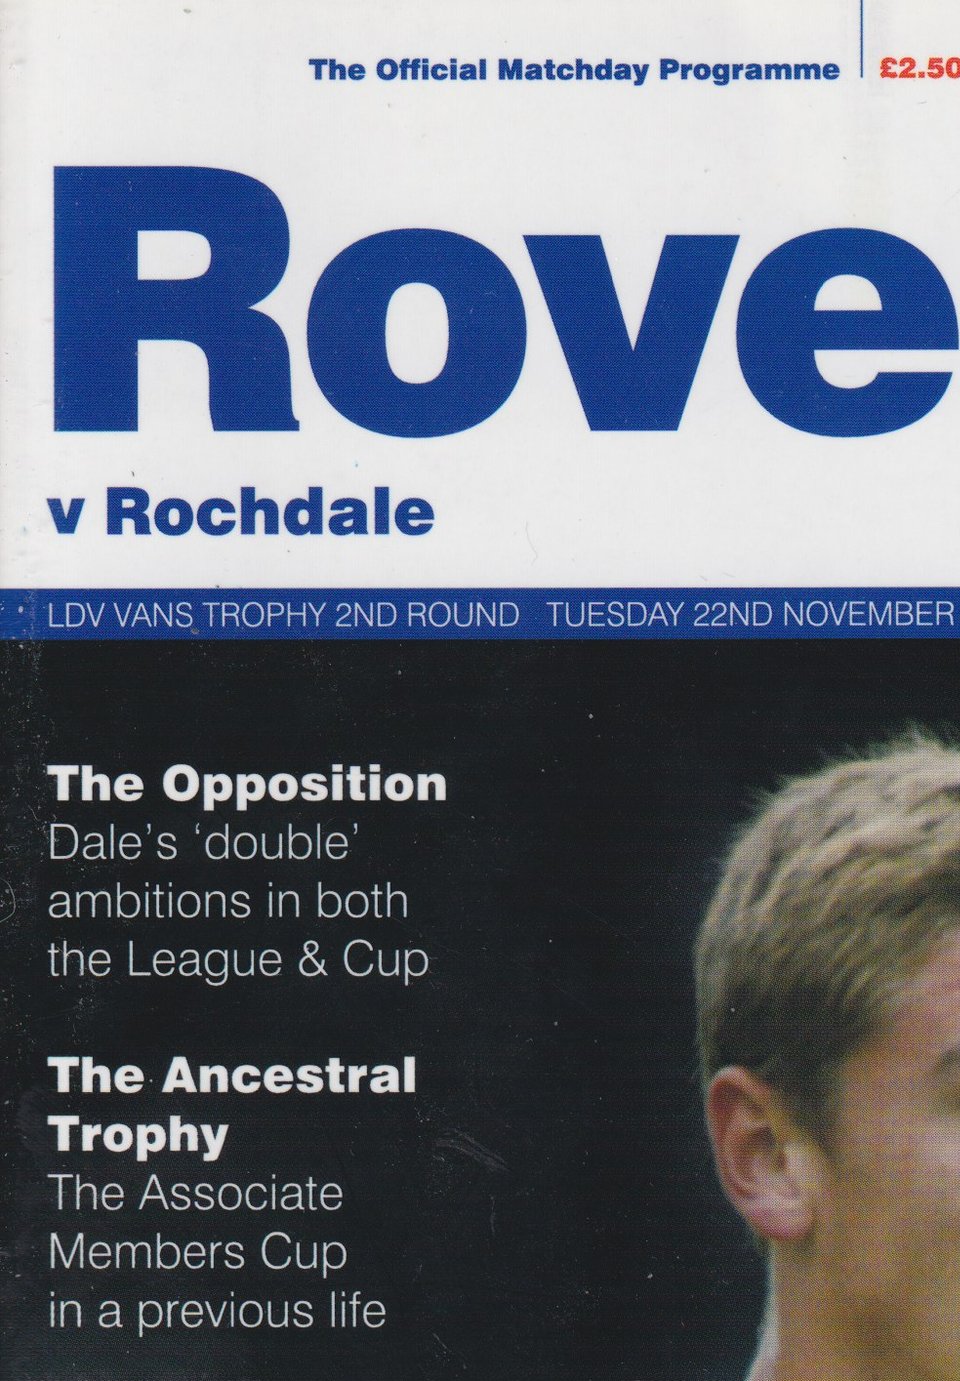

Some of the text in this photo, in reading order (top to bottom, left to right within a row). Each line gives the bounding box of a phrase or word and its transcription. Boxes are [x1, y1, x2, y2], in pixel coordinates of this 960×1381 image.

[309, 57, 840, 87] The Official Matchday Programme
[46, 486, 436, 537] v Rochdale
[48, 602, 106, 628] LDV
[113, 601, 194, 628] VANS
[202, 601, 327, 628] TROPHY
[335, 601, 398, 628] 2ND
[408, 601, 520, 628] ROUND
[546, 601, 685, 628] TUESDAY
[694, 601, 773, 627] 22ND
[783, 600, 955, 627] NOVEMBER
[47, 763, 447, 811] The Opposition
[50, 823, 178, 860] Dale’s
[48, 881, 408, 919] ambitions in both
[47, 939, 429, 987] the League & Cup
[47, 1056, 416, 1094] The Ancestral
[47, 1115, 230, 1162] Trophy
[48, 1173, 343, 1211] The Associate
[50, 1231, 347, 1279] Members Cup
[50, 1291, 386, 1336] in a previous life
